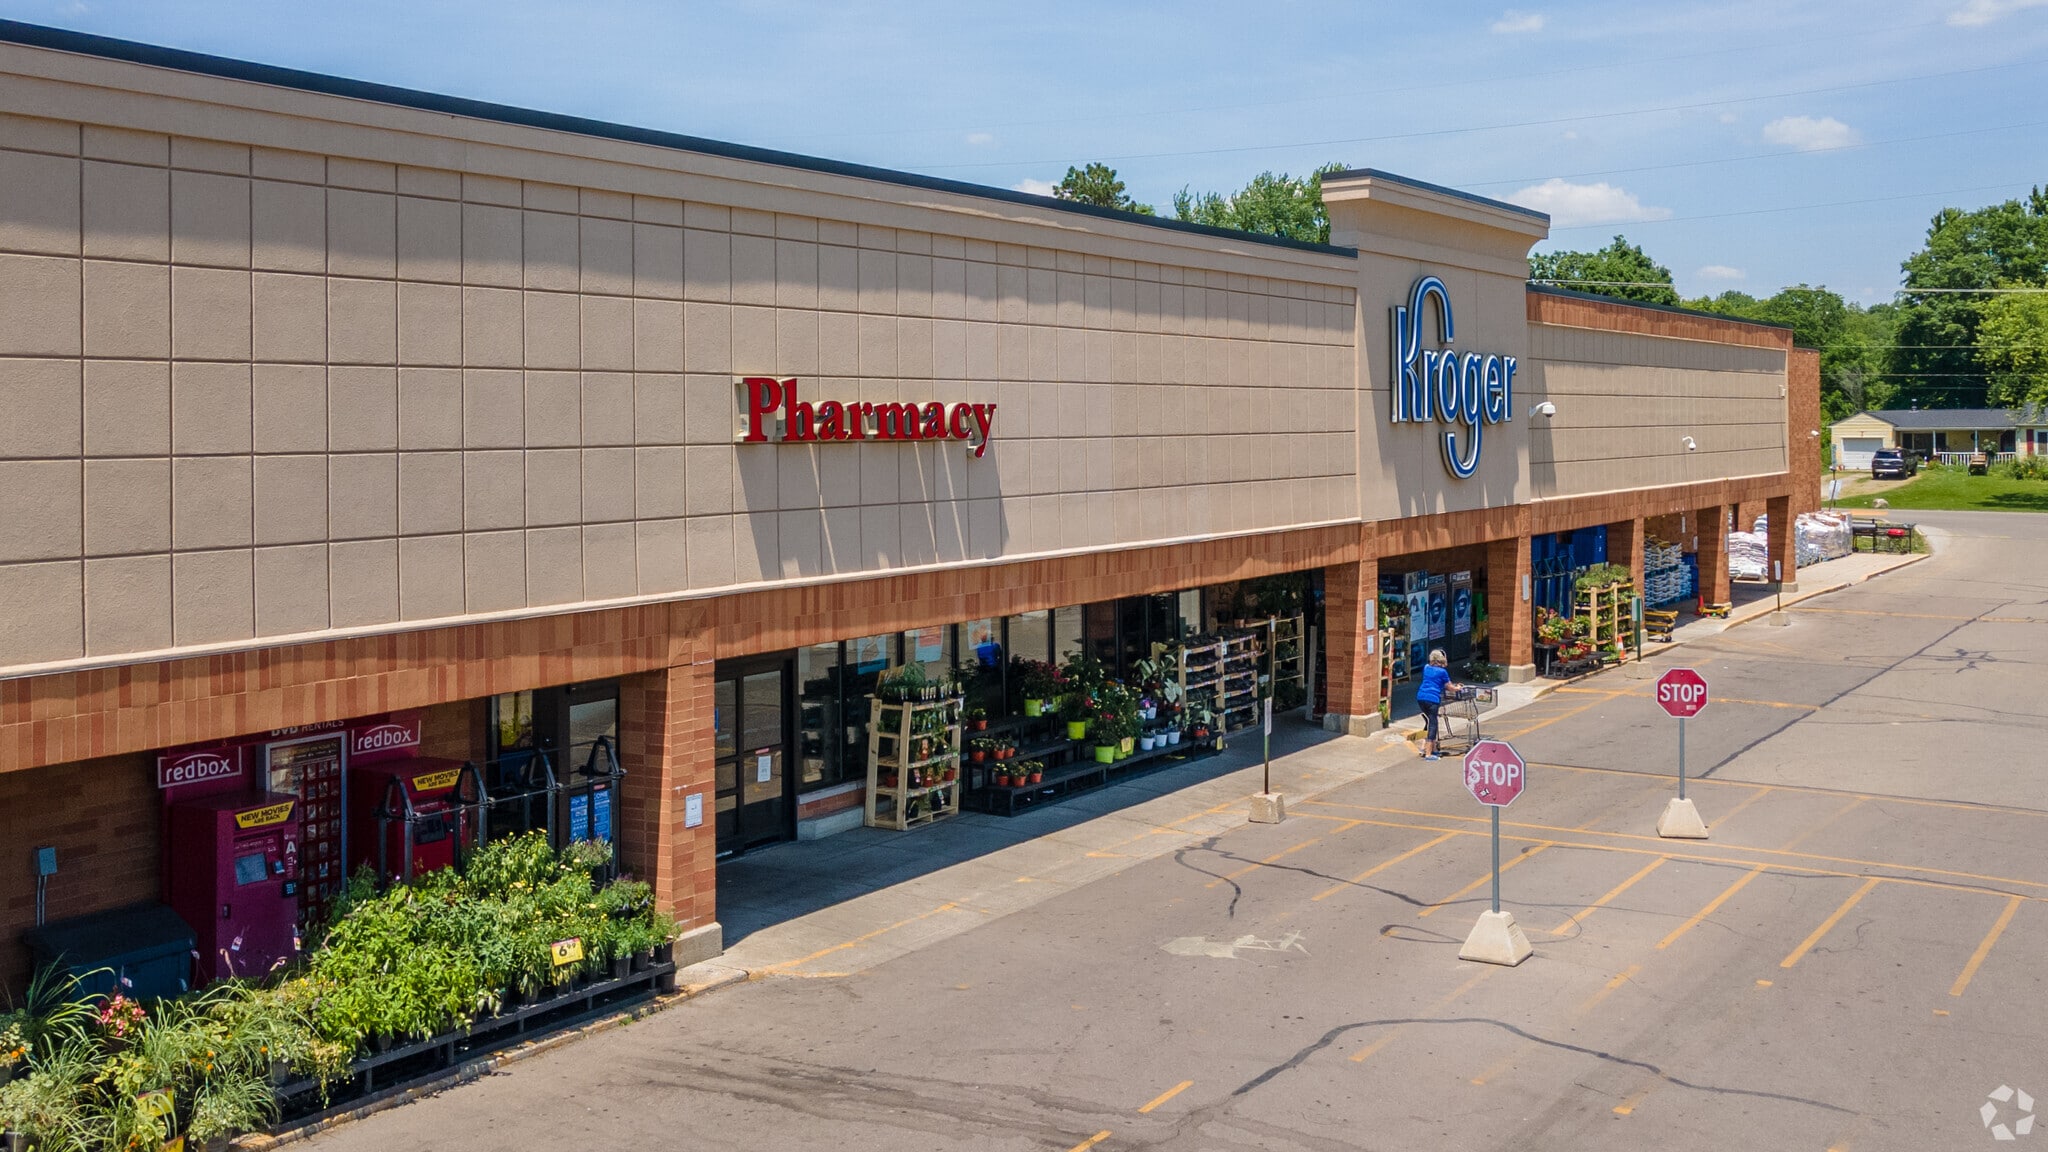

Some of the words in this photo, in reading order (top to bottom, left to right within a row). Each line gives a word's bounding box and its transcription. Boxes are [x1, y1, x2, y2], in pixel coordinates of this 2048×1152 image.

[1392, 275, 1518, 479] Kroger
[739, 376, 997, 458] Pharmacy
[1660, 683, 1705, 702] STOP
[358, 729, 412, 750] redbox
[166, 759, 231, 782] redbox
[417, 776, 433, 785] NEW
[1468, 760, 1520, 787] STOP
[241, 812, 259, 822] NEW
[261, 804, 290, 817] MOVIES
